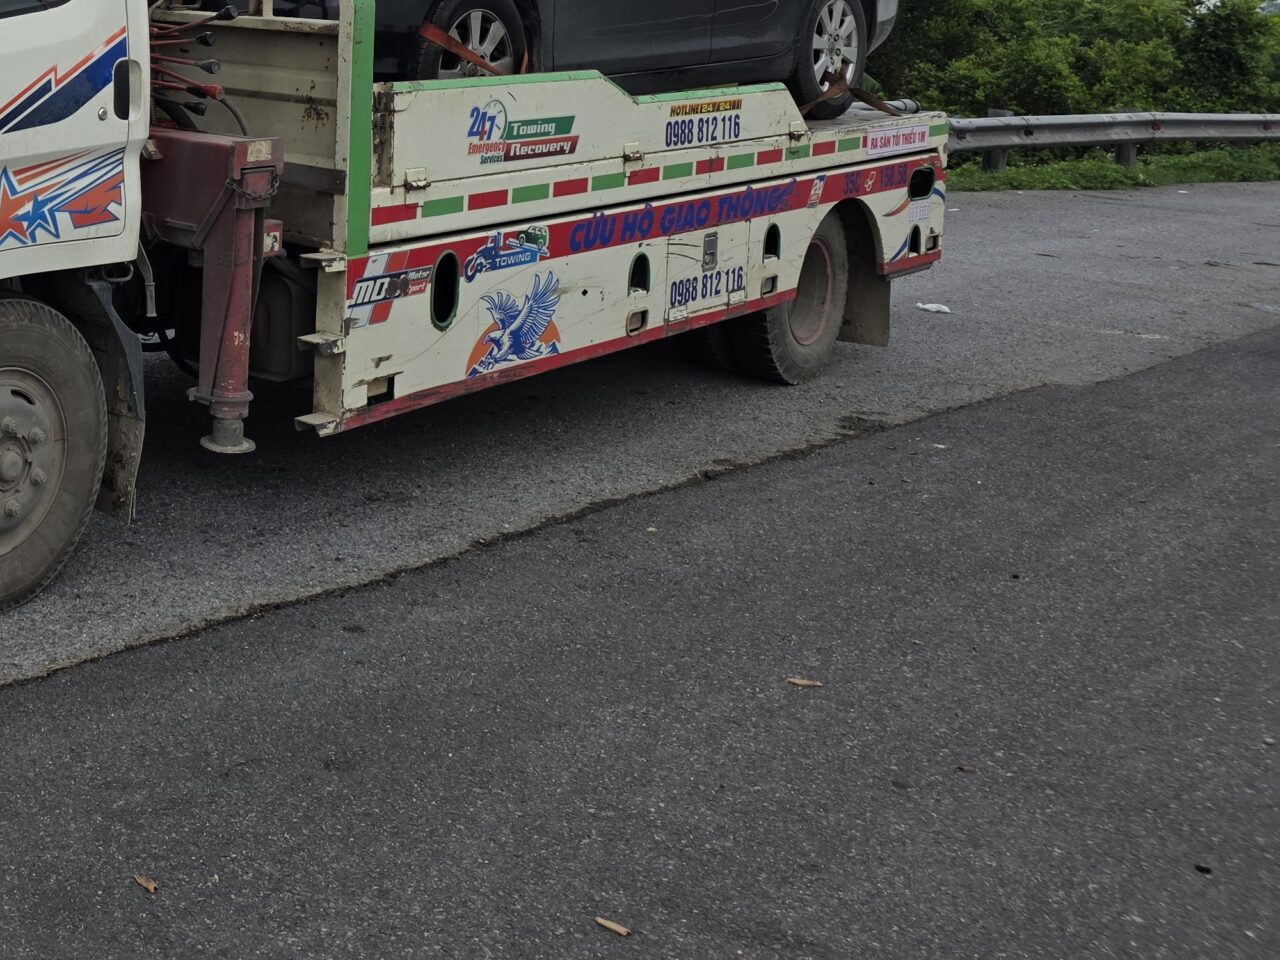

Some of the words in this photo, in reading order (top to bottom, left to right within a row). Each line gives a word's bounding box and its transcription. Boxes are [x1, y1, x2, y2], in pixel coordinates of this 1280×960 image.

[670, 104, 701, 117] HOTLINE
[511, 121, 556, 136] Towing
[665, 119, 694, 147] 0988
[697, 115, 718, 143] 812
[721, 113, 740, 139] 116
[468, 141, 507, 155] Emergency
[510, 140, 572, 156] Recovery
[480, 153, 503, 165] Services
[659, 198, 712, 234] GIAO
[495, 252, 532, 267] TOWING
[408, 270, 430, 280] Motor
[670, 276, 698, 308] 0988
[701, 270, 722, 299] 812
[725, 266, 744, 293] 116
